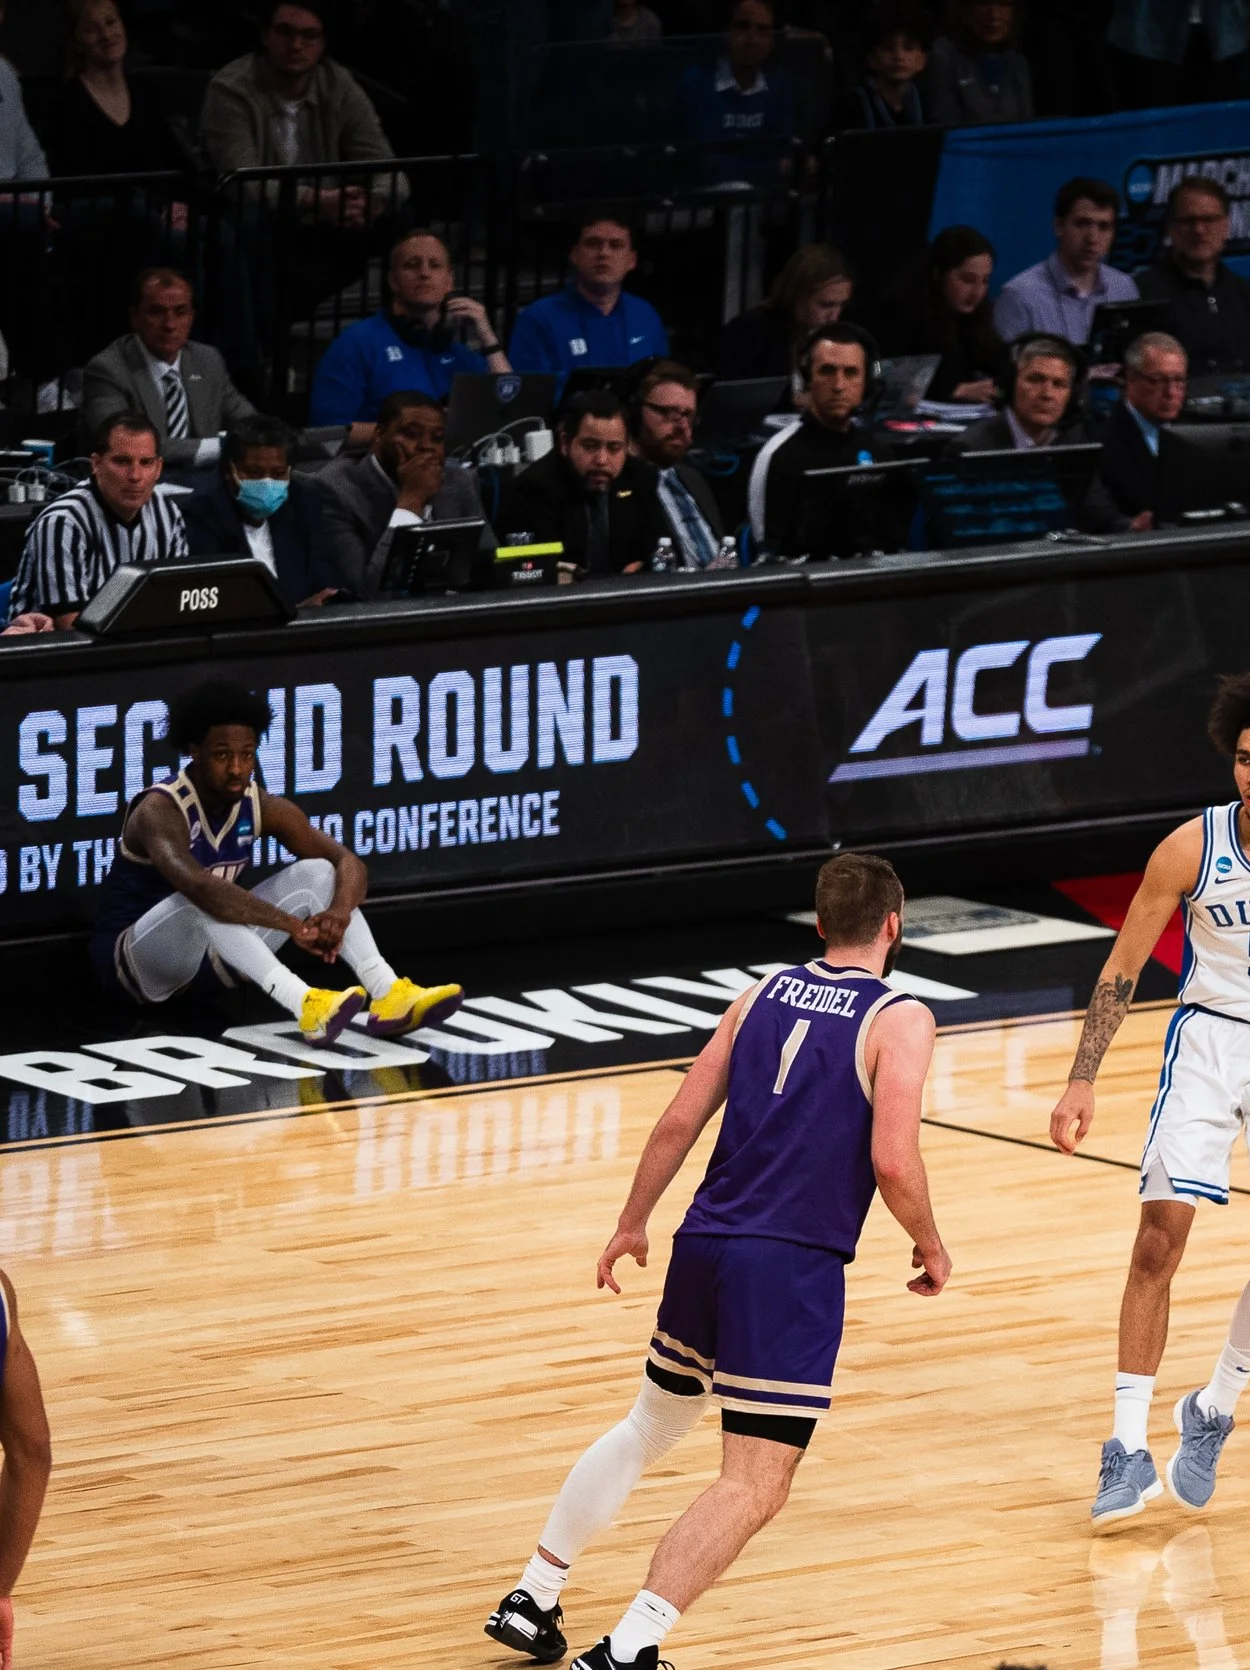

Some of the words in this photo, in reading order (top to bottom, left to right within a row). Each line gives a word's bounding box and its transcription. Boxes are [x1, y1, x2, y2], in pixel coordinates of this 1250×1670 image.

[180, 585, 219, 612] POSS
[848, 633, 1102, 753] ACC
[18, 682, 343, 823] SECND
[371, 654, 639, 787] ROUND
[19, 842, 63, 893] BY
[72, 836, 122, 888] TH
[353, 790, 560, 857] CONFERENCE
[767, 976, 859, 1018] FREIDEL
[773, 1018, 811, 1095] 1
[509, 1593, 529, 1605] GT
